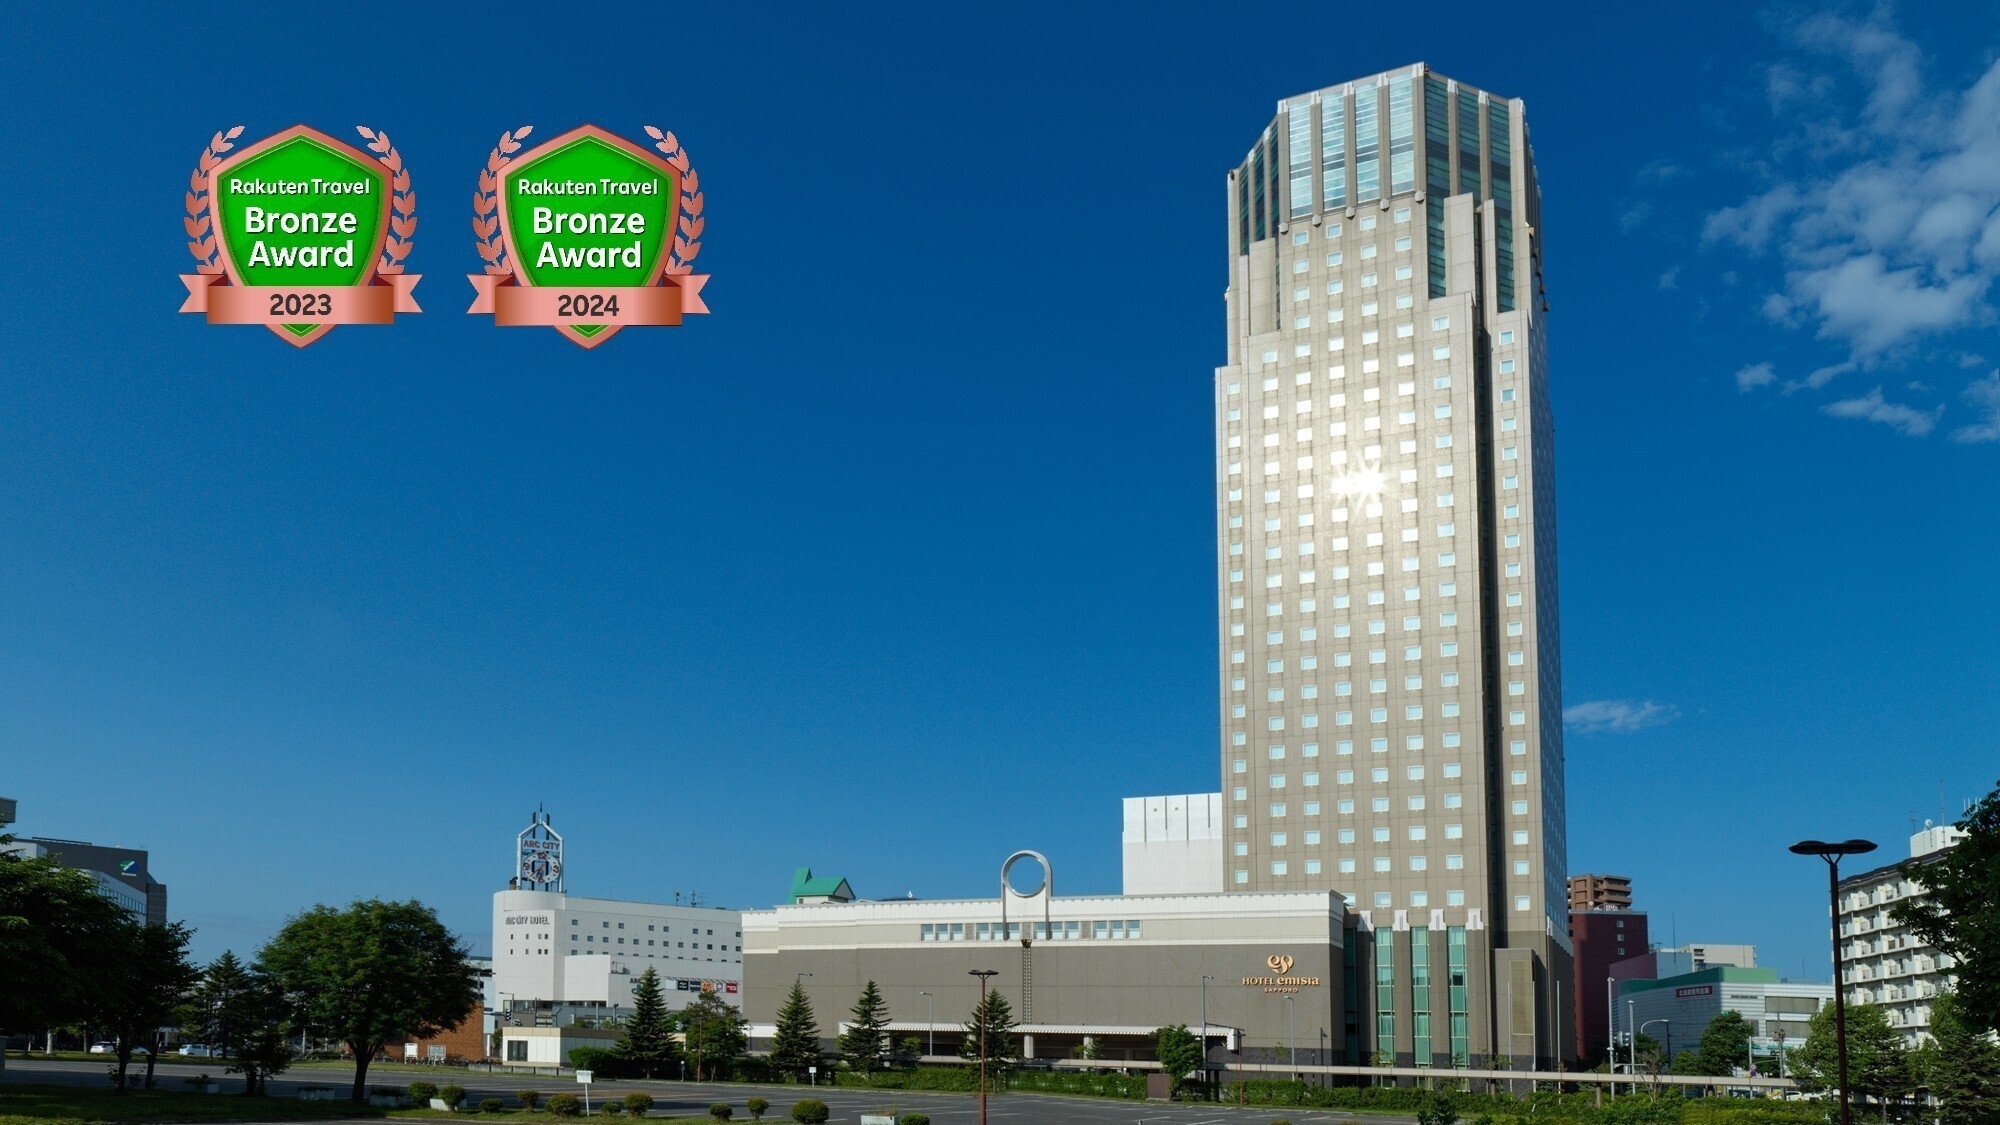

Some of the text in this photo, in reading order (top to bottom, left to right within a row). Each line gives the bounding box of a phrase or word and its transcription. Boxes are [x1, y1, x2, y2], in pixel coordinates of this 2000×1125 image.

[524, 840, 560, 850] ARC CITY
[530, 916, 550, 925] HOTEL
[1242, 977, 1319, 986] HOTEL emisia
